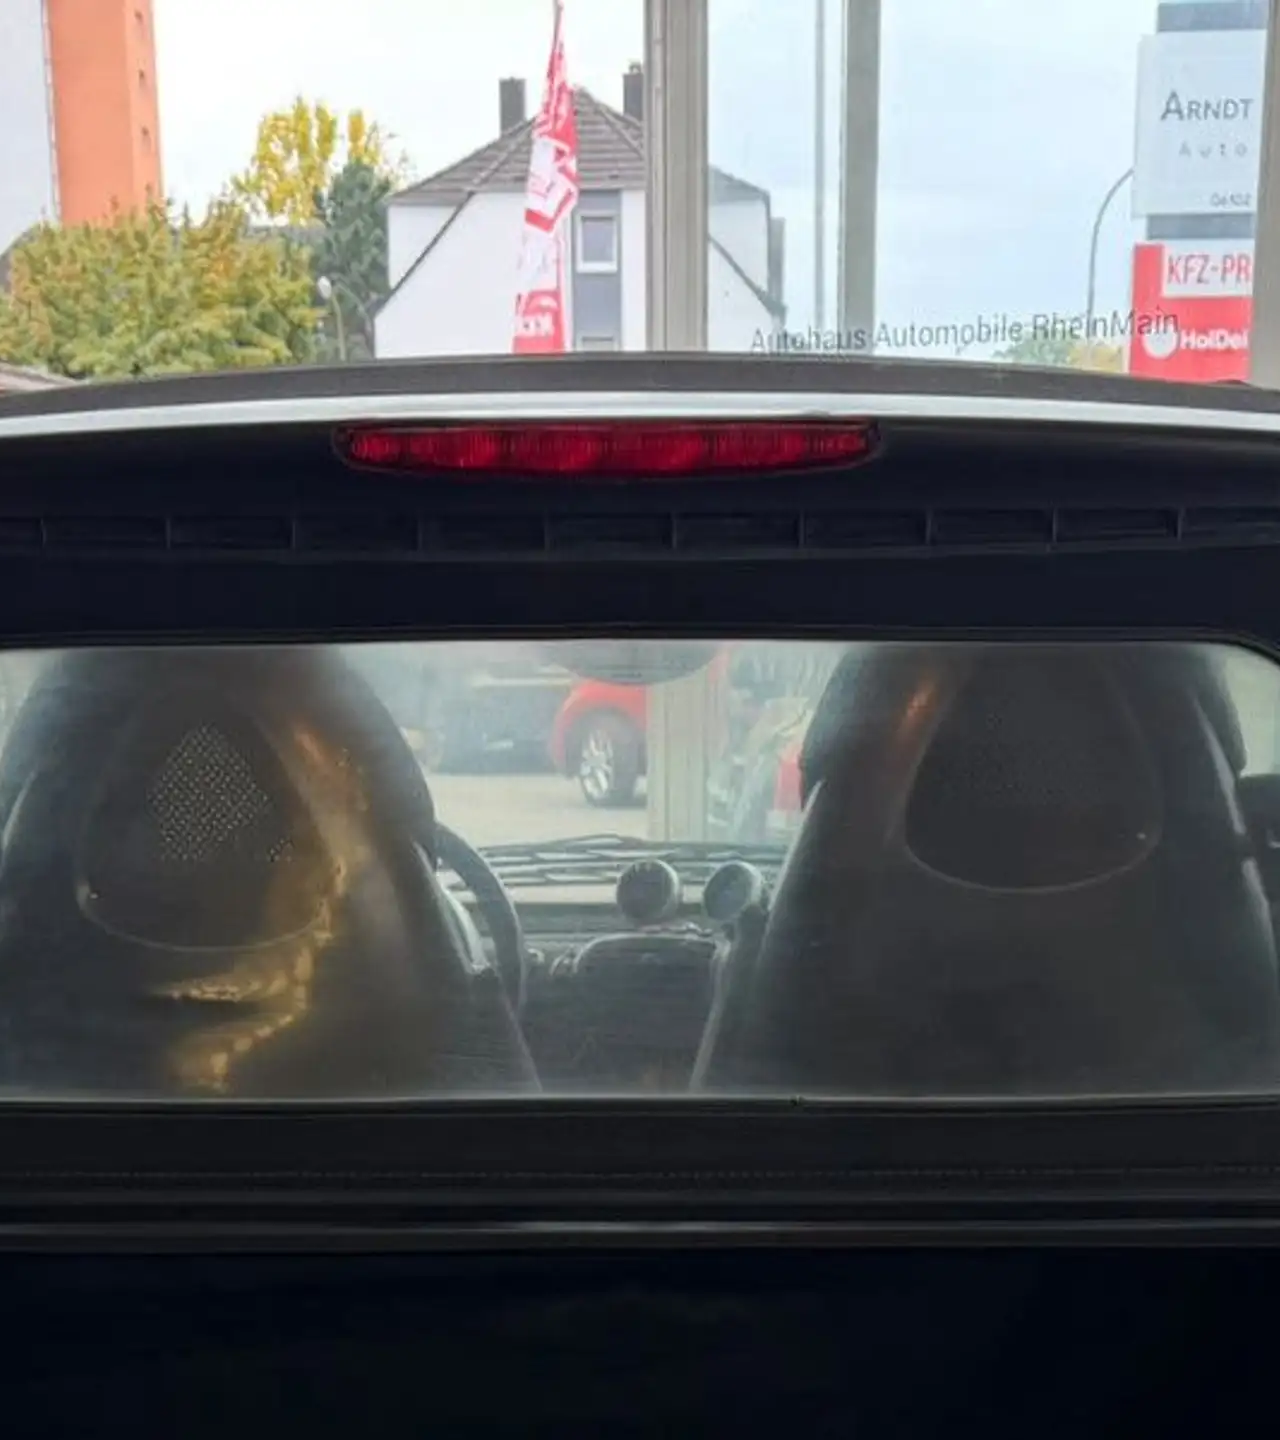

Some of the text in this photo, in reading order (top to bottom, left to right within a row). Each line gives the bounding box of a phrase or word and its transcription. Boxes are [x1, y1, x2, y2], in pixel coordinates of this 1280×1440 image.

[1160, 91, 1255, 121] ARNDT
[751, 306, 1179, 351] Autohaus Automobile RheinMain
